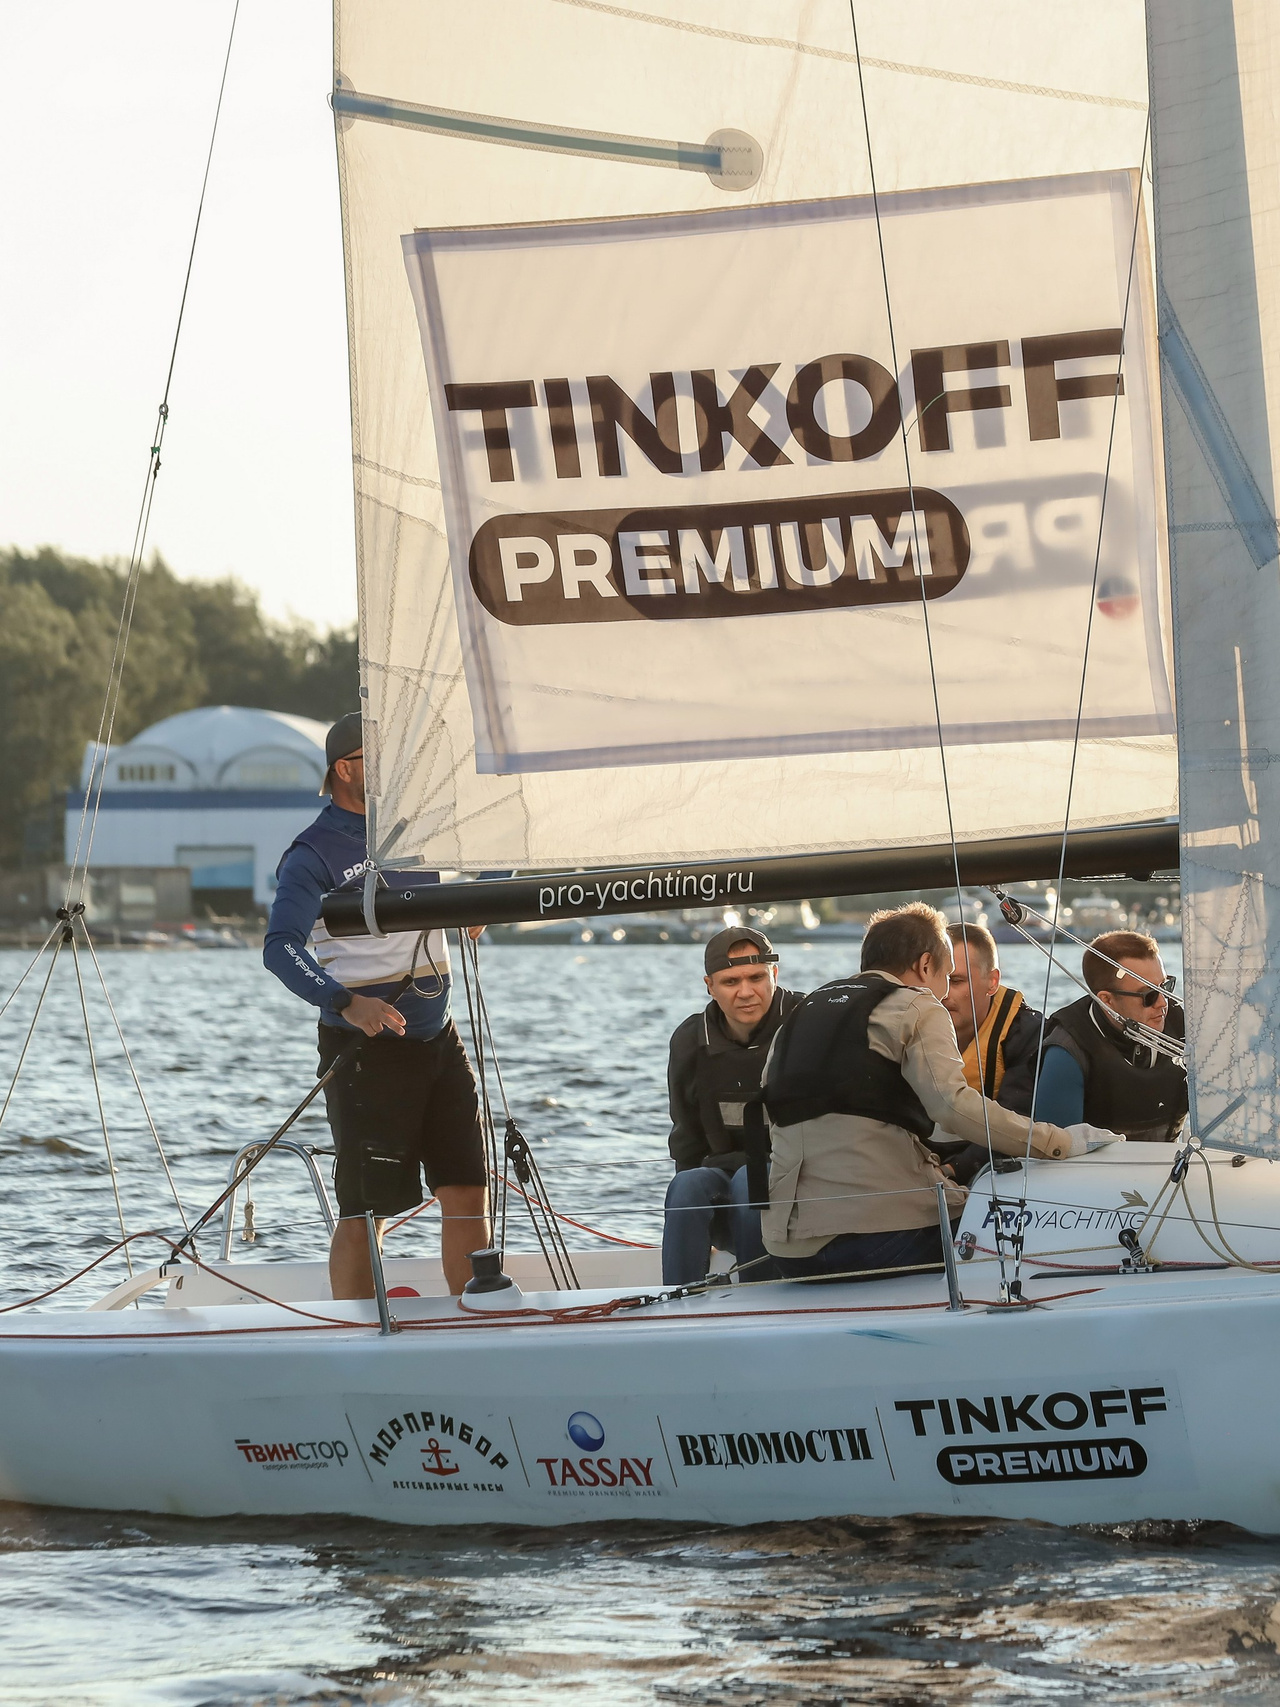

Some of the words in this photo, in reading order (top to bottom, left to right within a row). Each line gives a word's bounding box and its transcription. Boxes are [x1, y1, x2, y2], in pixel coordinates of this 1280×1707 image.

[443, 326, 1126, 483] TINKOFF
[498, 509, 934, 602] PREMIUM
[538, 869, 754, 915] pro-yachting.ru
[894, 1387, 1167, 1436] TINKOFF
[370, 1411, 509, 1470] МОРПРИБОР
[676, 1428, 873, 1470] ВЕДОМОСТИ
[948, 1445, 1134, 1477] PREMIUM
[392, 1480, 470, 1491] ЛЕГЕНДАРНЫЕ
[473, 1483, 504, 1492] ЧАСЫ
[536, 1457, 654, 1487] TASSAY
